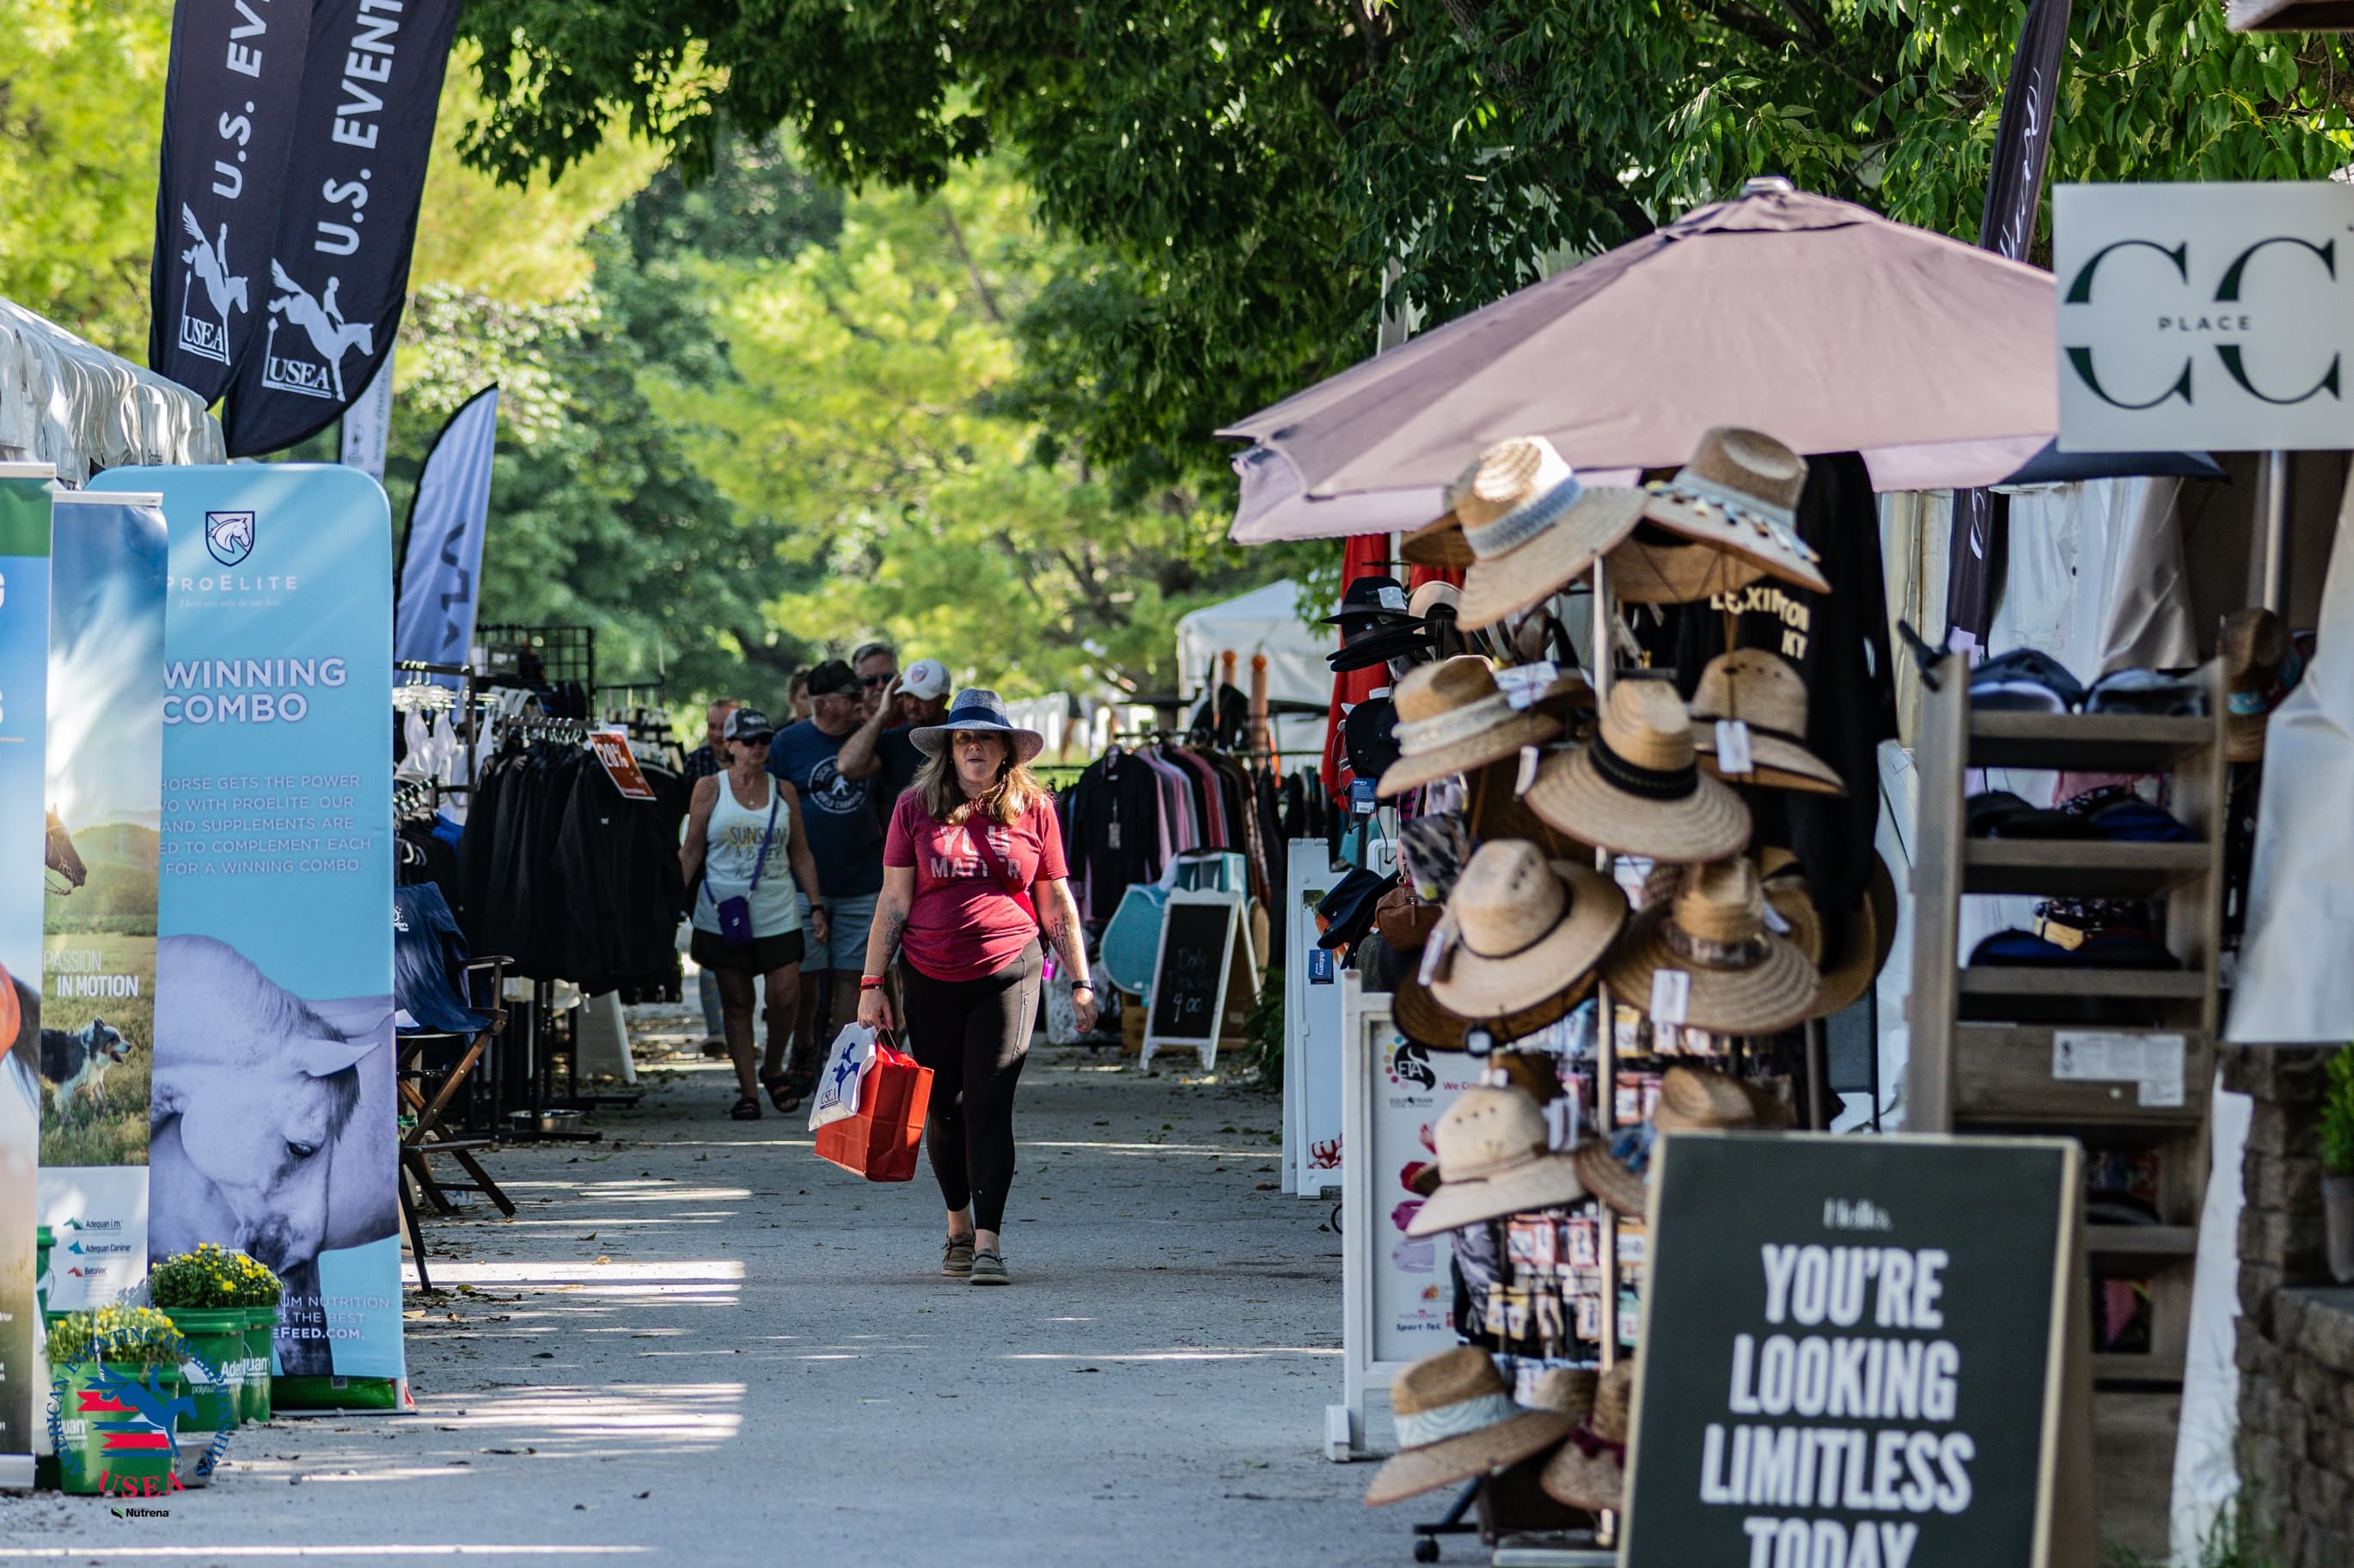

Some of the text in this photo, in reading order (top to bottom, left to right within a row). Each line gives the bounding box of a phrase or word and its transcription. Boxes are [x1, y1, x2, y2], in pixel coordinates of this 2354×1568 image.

[212, 0, 269, 199] U.S. EV
[313, 168, 372, 256] U.S.
[182, 315, 225, 352] USEA
[2157, 315, 2252, 332] PLACE
[268, 356, 332, 391] USEA
[163, 658, 346, 689] WINNING
[162, 692, 308, 724] COMBO
[218, 777, 258, 790] GETS
[266, 776, 296, 788] THE
[302, 775, 360, 788] POWER
[186, 798, 227, 811] WITH
[319, 796, 354, 809] OUR
[162, 817, 354, 833] AND SUPPLEMENTS ARE
[185, 840, 206, 854] TO
[212, 838, 321, 854] COMPLEMENT
[327, 838, 371, 851] EACH
[166, 858, 364, 876] FOR A WINNING COMBO.
[929, 857, 1022, 879] MATTR
[44, 949, 102, 973] PASSION
[57, 974, 139, 997] IN MOTION
[1443, 1082, 1459, 1090] We
[85, 1220, 110, 1229] Adequan
[85, 1242, 130, 1253] Adequan Canine
[1760, 1242, 1949, 1330] YOU'RE
[308, 1296, 390, 1309] NUTRITION
[293, 1311, 322, 1324] THE
[328, 1311, 365, 1324] BEST
[1395, 1322, 1441, 1332] Sport-Tek
[1728, 1333, 1960, 1421] LOOKING
[1699, 1423, 1976, 1514] LIMITLESS
[1743, 1516, 1919, 1568] TODAY
